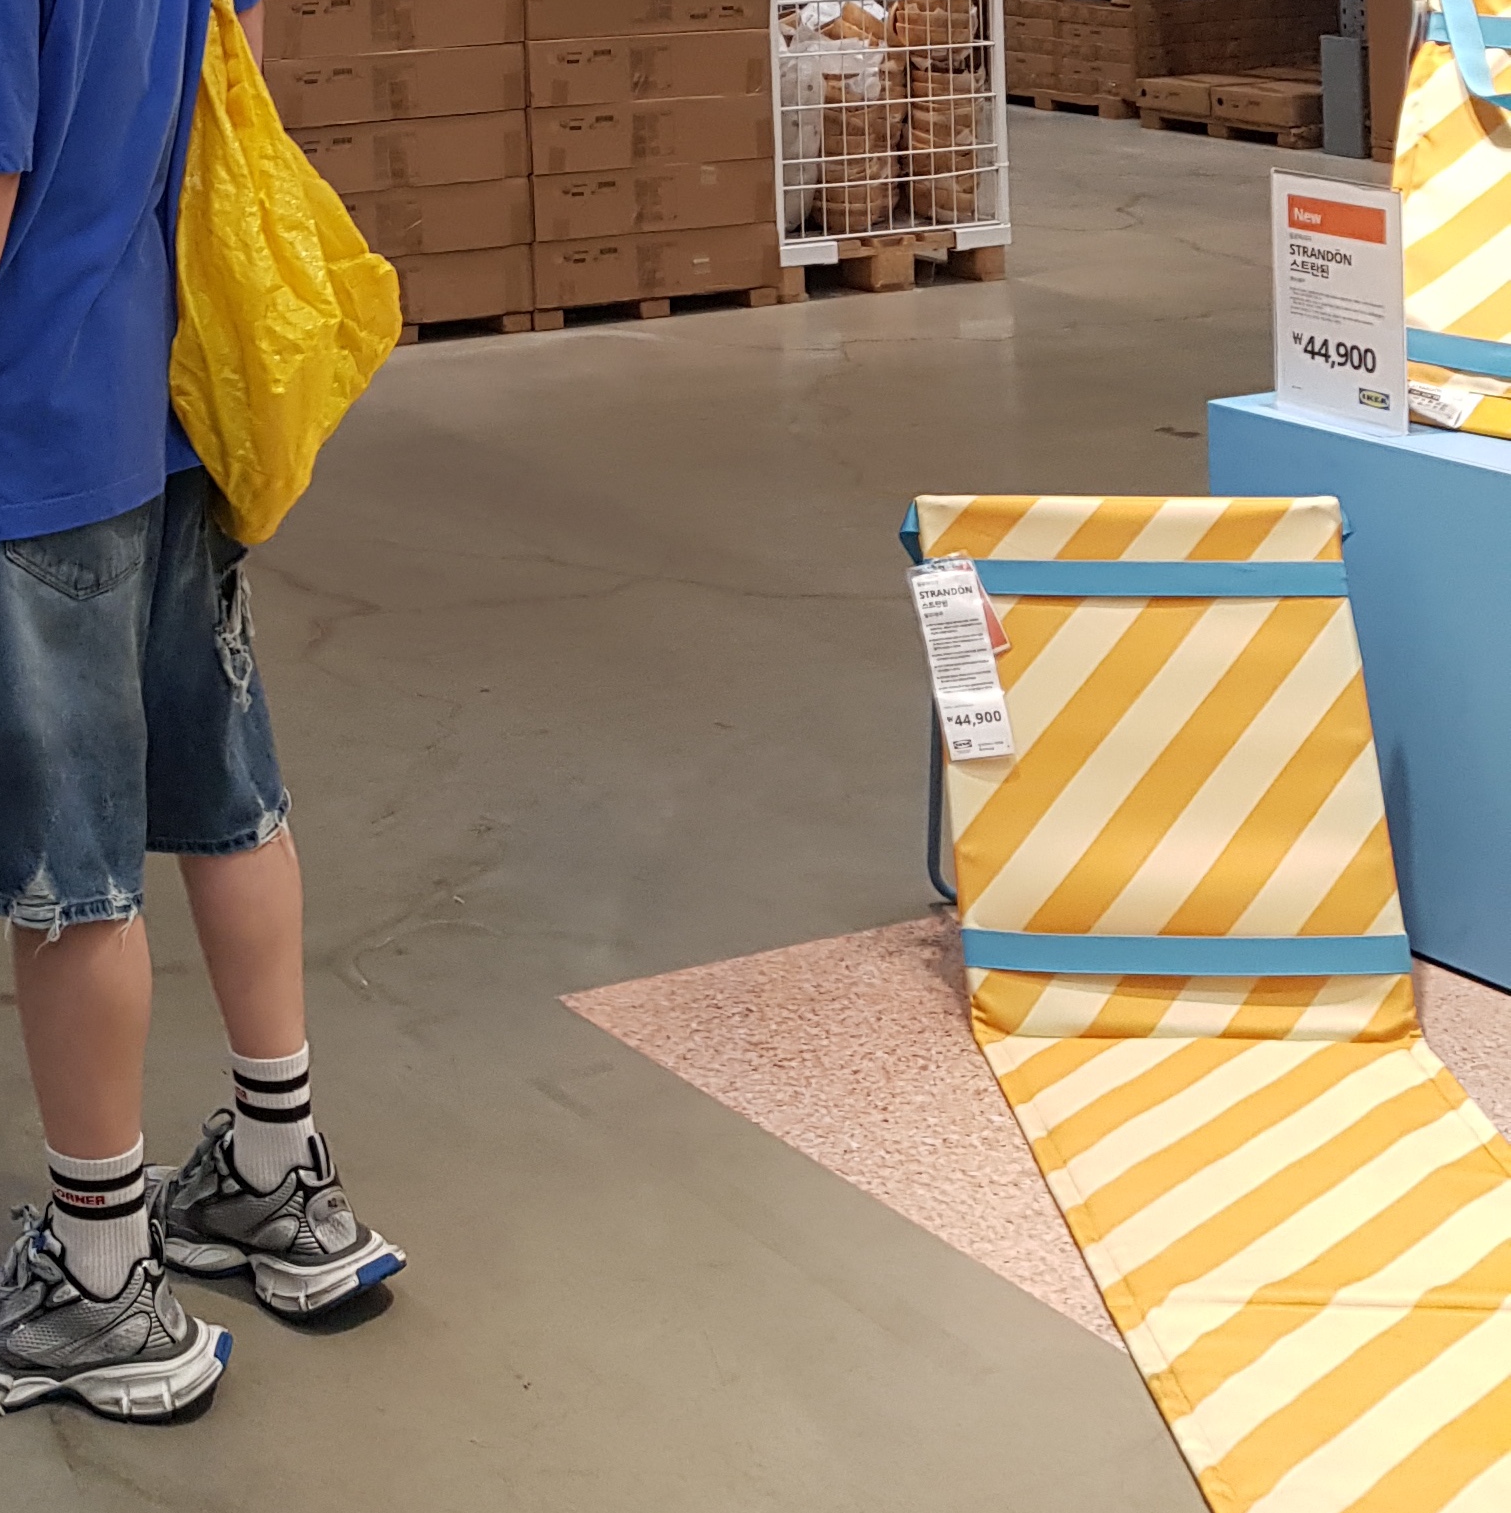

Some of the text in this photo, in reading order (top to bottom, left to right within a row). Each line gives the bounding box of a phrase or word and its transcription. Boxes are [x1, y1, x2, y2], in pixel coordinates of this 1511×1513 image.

[1293, 206, 1322, 225] New
[1289, 243, 1353, 267] STRANDÖN
[1292, 330, 1377, 374] ₩44,900
[53, 1188, 106, 1206] ORNER
